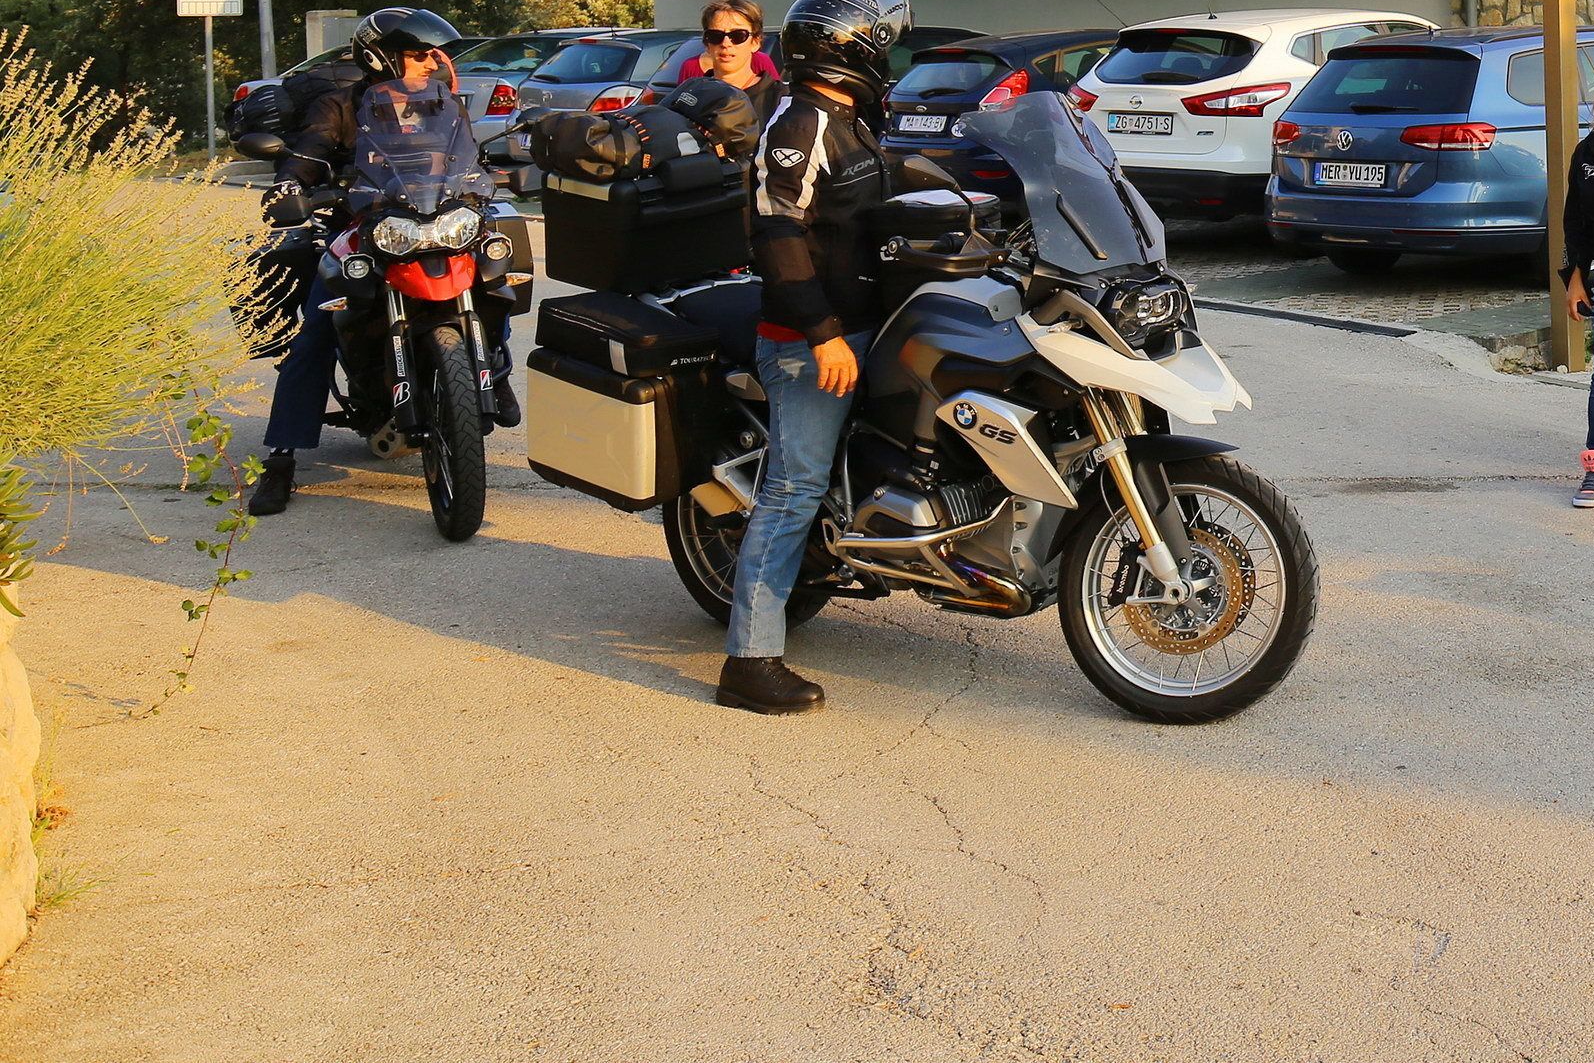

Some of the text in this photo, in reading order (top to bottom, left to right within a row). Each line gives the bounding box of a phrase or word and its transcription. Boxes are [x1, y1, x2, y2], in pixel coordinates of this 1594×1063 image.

[1115, 116, 1170, 130] ZG 4751-S
[1320, 164, 1384, 181] MER YU 195
[979, 423, 1018, 445] GS
[1116, 564, 1130, 594] brembo
